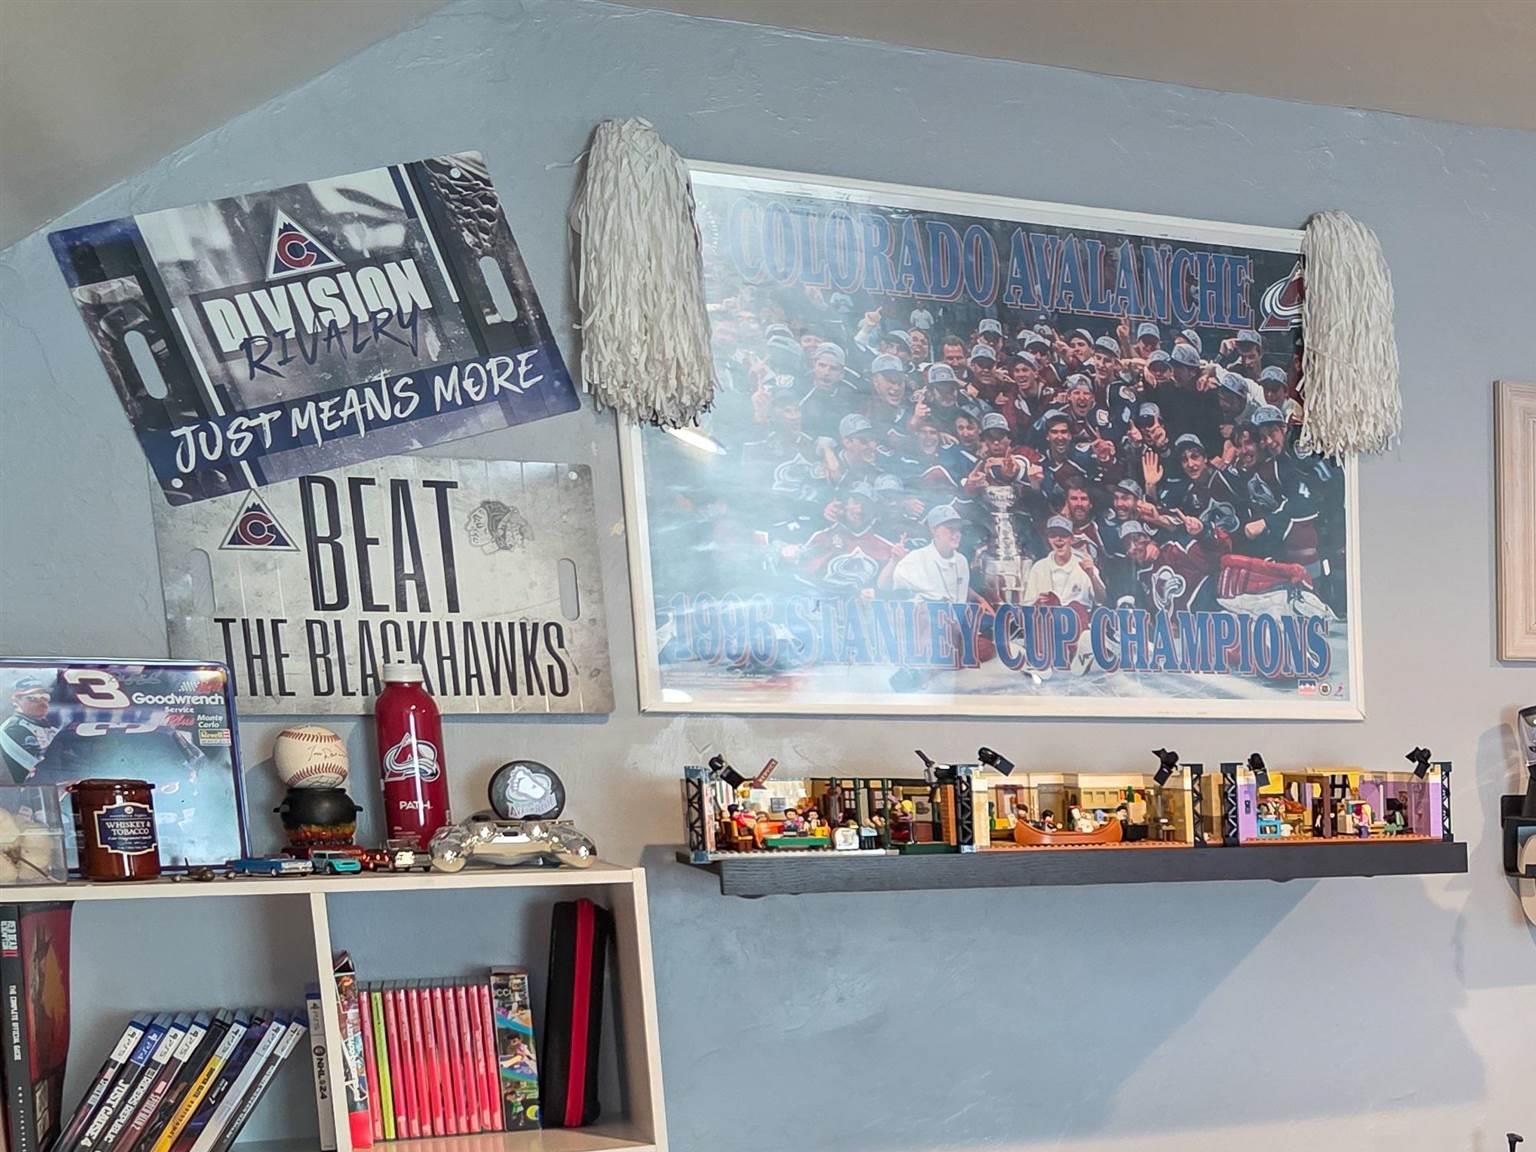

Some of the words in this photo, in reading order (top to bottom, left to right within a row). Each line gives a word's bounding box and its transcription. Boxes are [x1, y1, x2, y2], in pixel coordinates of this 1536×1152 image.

[728, 197, 1000, 308] COLORADO
[1004, 226, 1256, 333] AVALANCHE
[202, 257, 432, 352] DIVISION
[240, 311, 426, 380] RIVALRY
[170, 411, 280, 475] JUST
[290, 369, 421, 445] MEANS
[434, 349, 545, 416] MORE
[299, 476, 462, 614] BEAT
[672, 592, 778, 668] 1996
[785, 596, 983, 670] STANLEY
[993, 603, 1082, 671] CUP
[1090, 606, 1332, 679] CHAMPIONS
[214, 618, 296, 698] THE
[306, 619, 571, 698] BLACKHAWKS
[64, 669, 130, 709] 3
[132, 692, 225, 705] Goodwrench
[164, 706, 195, 714] Service
[196, 714, 224, 722] Monte
[105, 821, 148, 829] WHISKEY
[111, 828, 150, 836] TOBACCO
[316, 1057, 325, 1081] NHL
[105, 1077, 130, 1109] JUST
[126, 1074, 152, 1108] RIDERS
[319, 1084, 328, 1100] 24
[85, 1103, 114, 1141] CAUSE
[102, 1102, 134, 1146] REPUBLIC
[79, 1135, 94, 1150] 4
